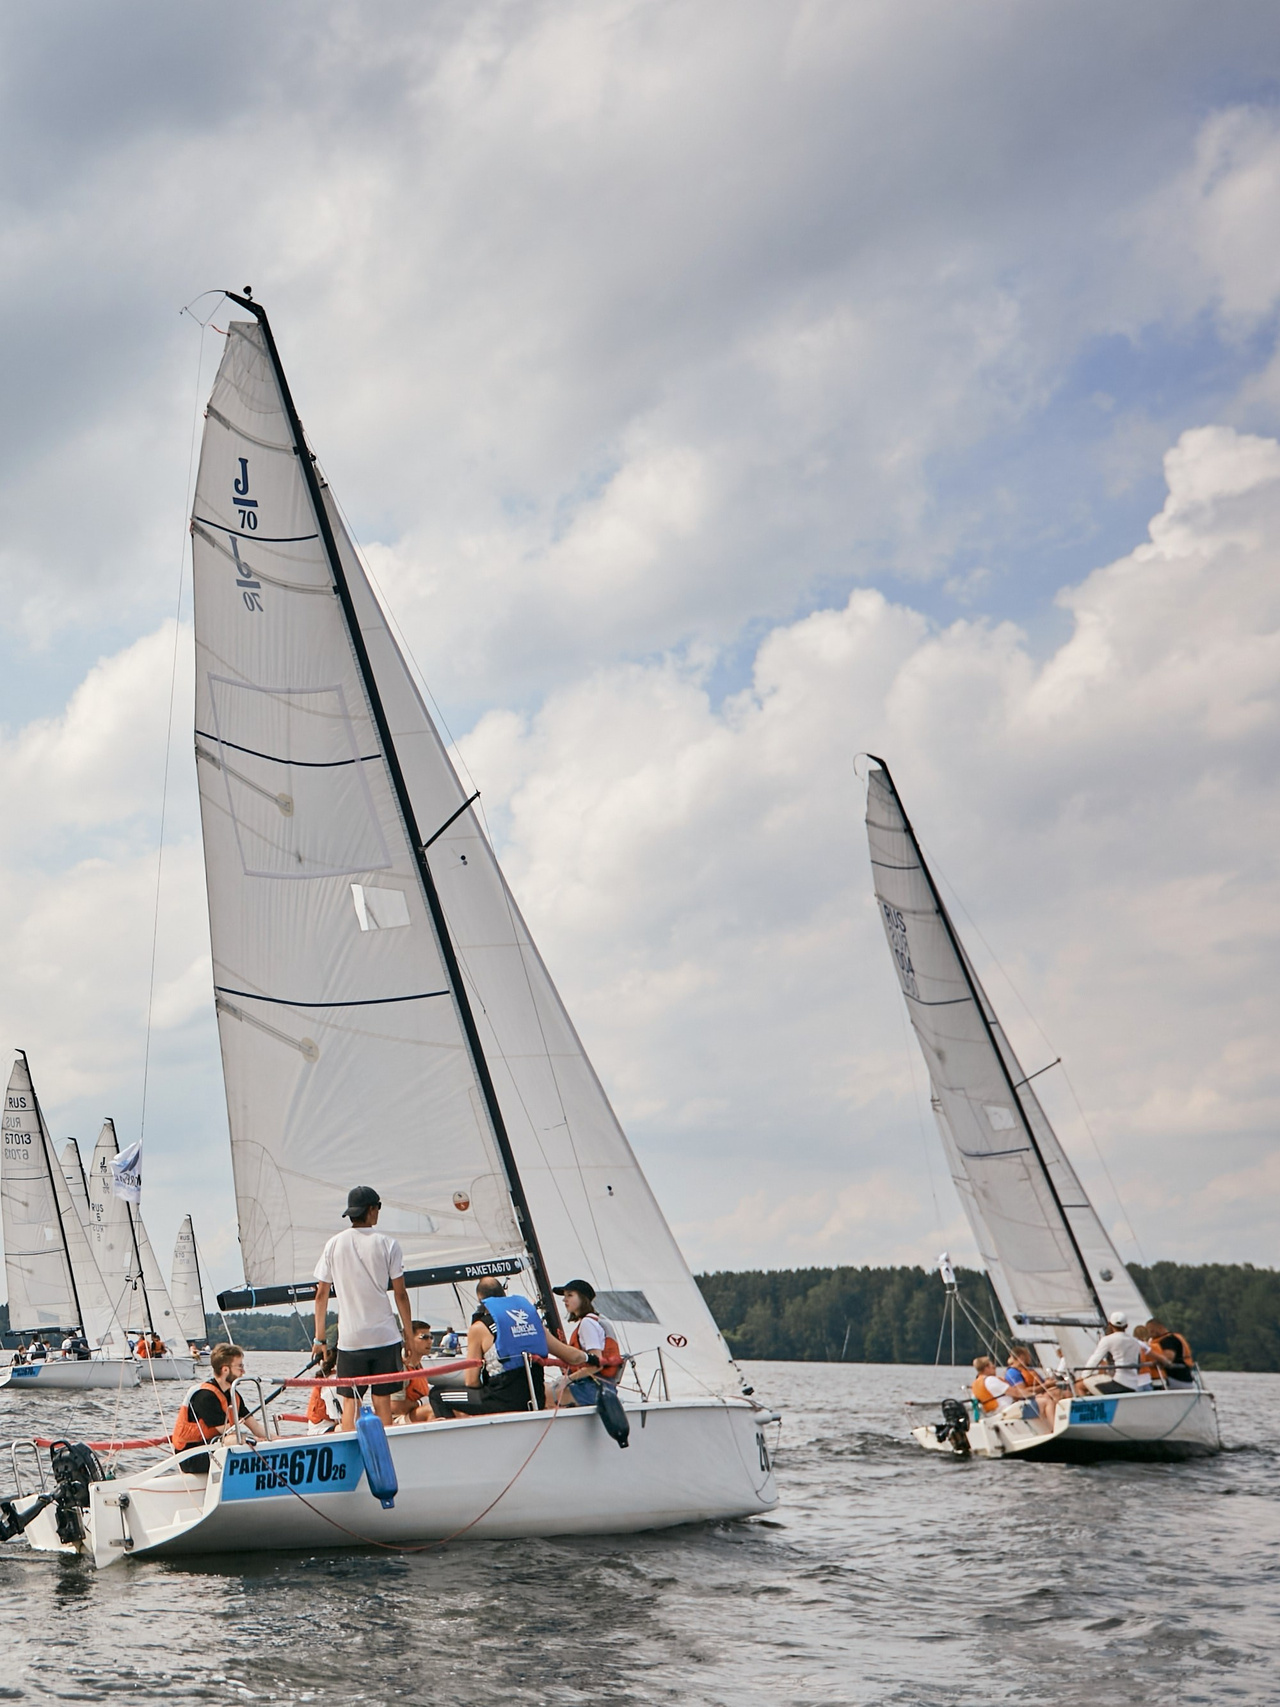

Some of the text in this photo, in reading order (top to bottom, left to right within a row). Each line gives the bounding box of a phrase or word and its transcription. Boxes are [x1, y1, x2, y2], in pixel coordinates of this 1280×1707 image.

[233, 457, 249, 496] J
[238, 509, 258, 531] 70
[883, 903, 907, 933] RUS
[8, 1097, 27, 1109] RUS
[5, 1133, 32, 1145] 67013
[91, 1202, 104, 1213] RUS
[465, 1262, 511, 1277] PAKETA670
[229, 1446, 346, 1486] PAKETA 670 26
[255, 1472, 288, 1491] RUS
